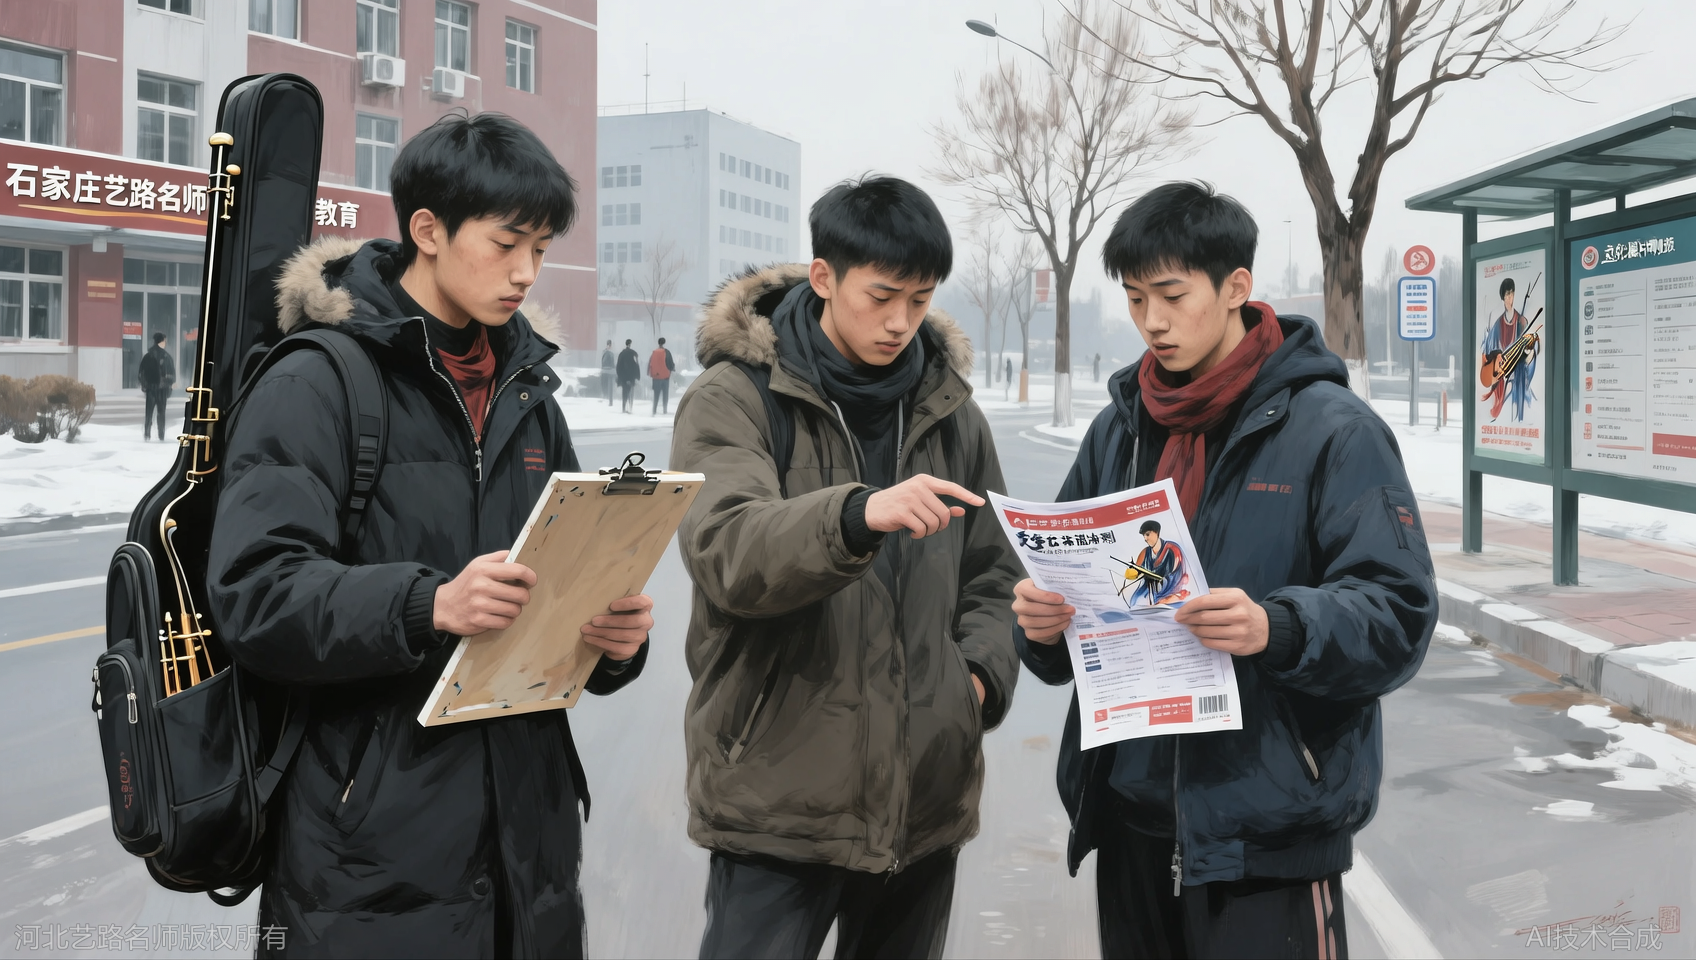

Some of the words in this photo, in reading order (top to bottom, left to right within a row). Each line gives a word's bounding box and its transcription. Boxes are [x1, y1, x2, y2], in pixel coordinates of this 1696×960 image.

[5, 162, 208, 216] 石家庄艺路名师
[315, 197, 360, 229] 教育
